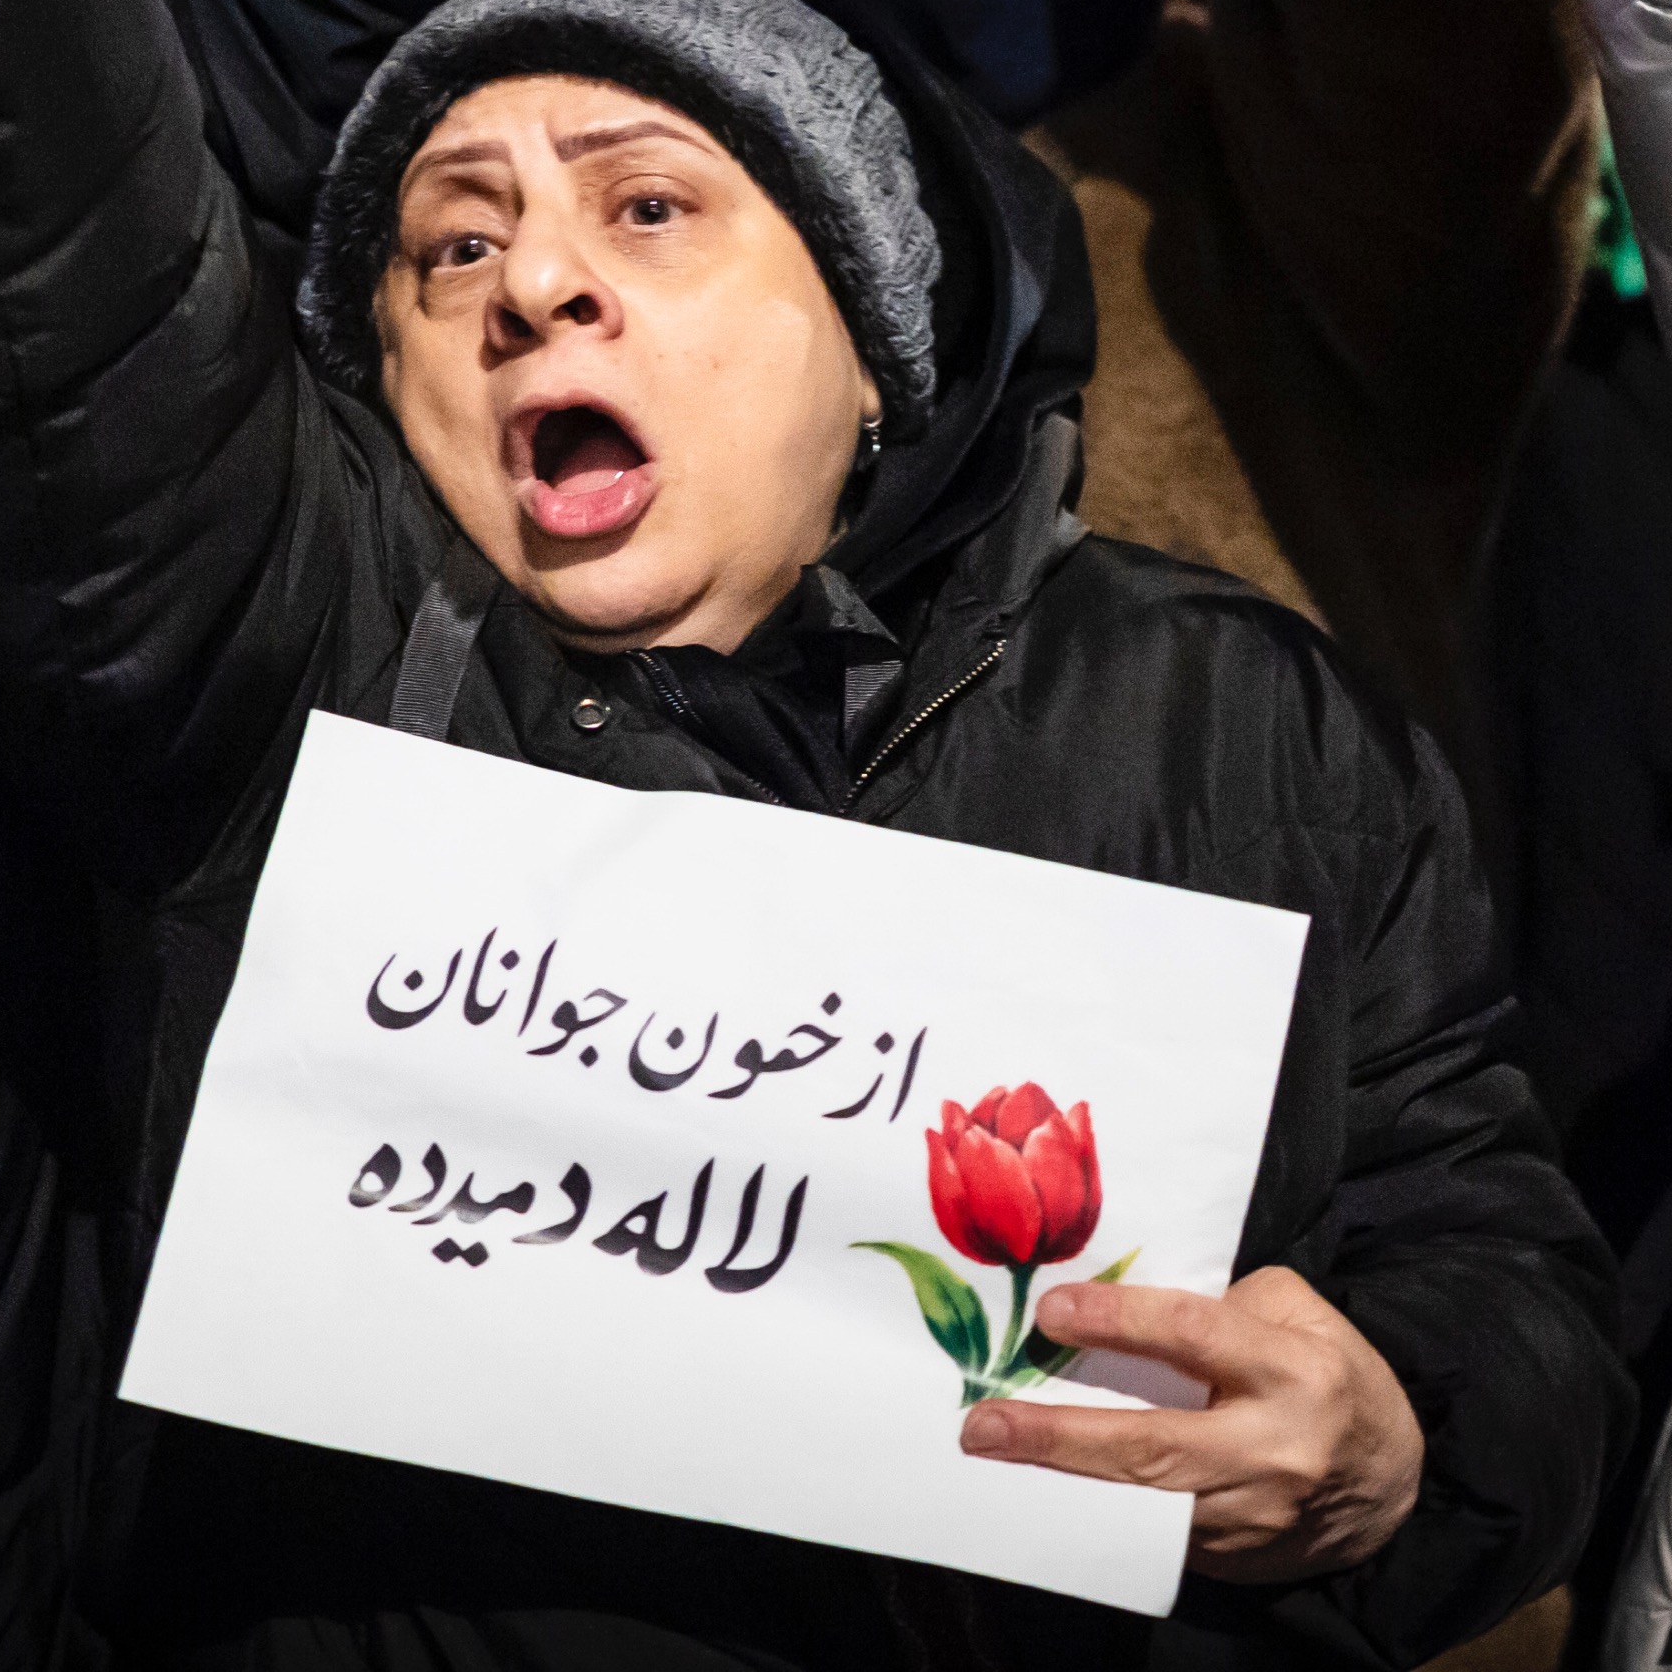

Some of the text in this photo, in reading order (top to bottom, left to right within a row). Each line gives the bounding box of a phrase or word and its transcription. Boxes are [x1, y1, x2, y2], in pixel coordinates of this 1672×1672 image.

[365, 927, 928, 1122] از خون جوانان
[347, 1141, 594, 1269] دمیده
